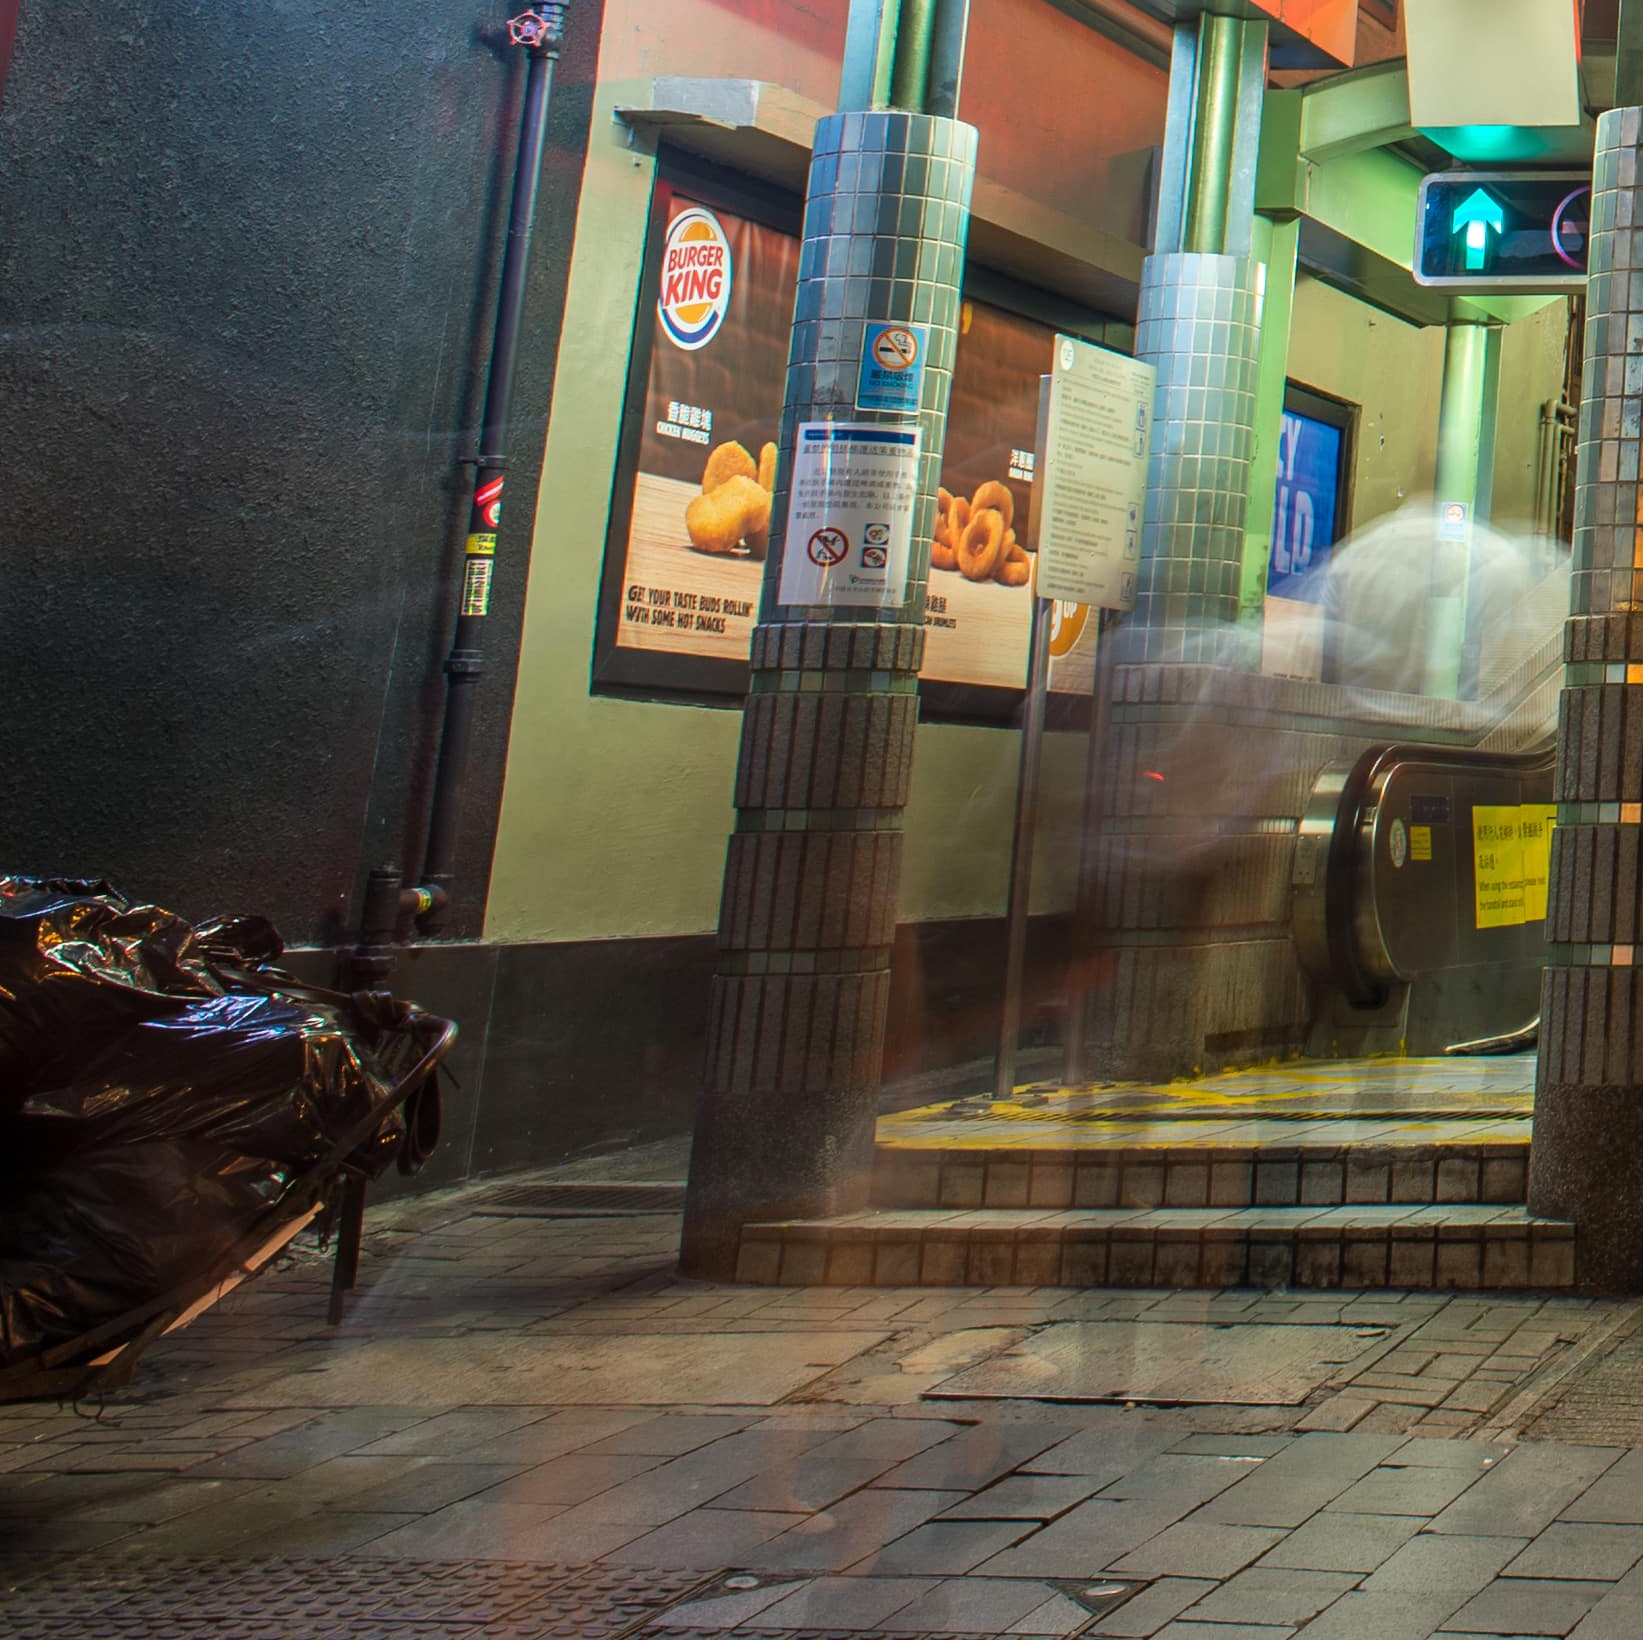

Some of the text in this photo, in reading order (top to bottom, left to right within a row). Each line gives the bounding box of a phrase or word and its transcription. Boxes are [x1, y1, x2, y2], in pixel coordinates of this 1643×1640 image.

[667, 244, 724, 273] BURGER
[663, 267, 723, 308] KING
[627, 585, 646, 603] GET
[648, 588, 672, 607] YOUR
[674, 591, 698, 611] TASTE
[699, 595, 721, 614] BUDS
[625, 604, 726, 635] WITH SOME HOT SNACKS
